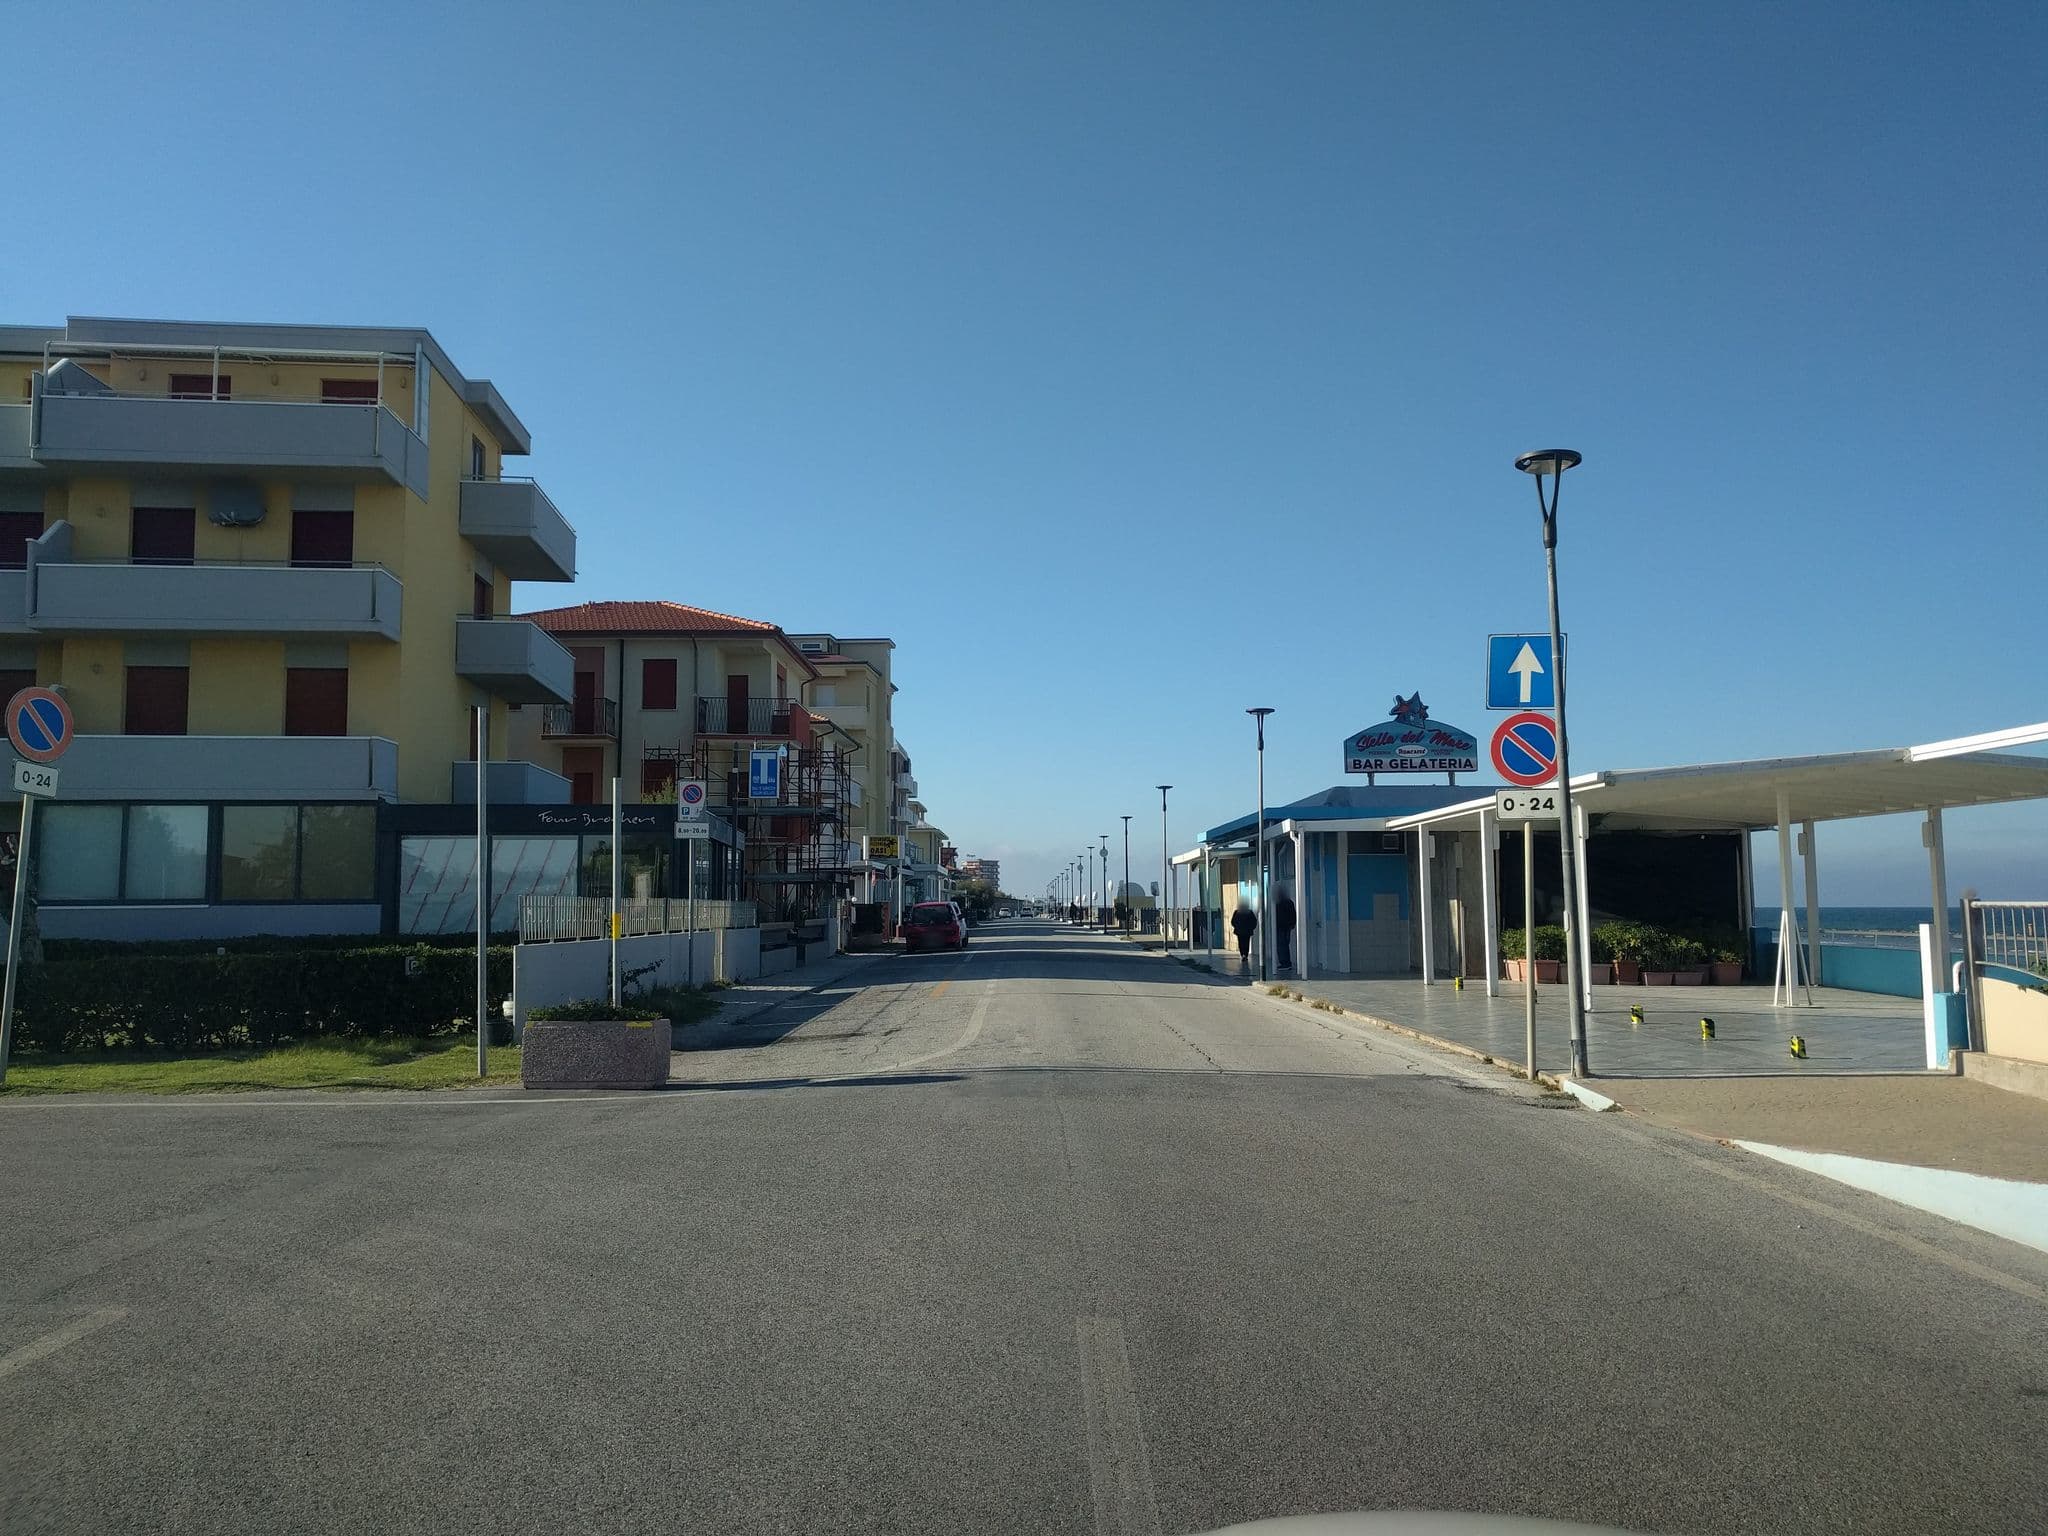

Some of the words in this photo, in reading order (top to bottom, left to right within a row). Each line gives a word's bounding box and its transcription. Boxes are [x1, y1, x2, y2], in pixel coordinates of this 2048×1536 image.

[1356, 731, 1396, 751] Stella
[1401, 729, 1425, 744] del
[1427, 728, 1473, 751] Mare
[1352, 758, 1384, 770] BAR
[1388, 758, 1474, 770] GELATERIA
[22, 770, 51, 788] 0-24
[538, 810, 577, 824] Four
[582, 811, 656, 827] Brohers
